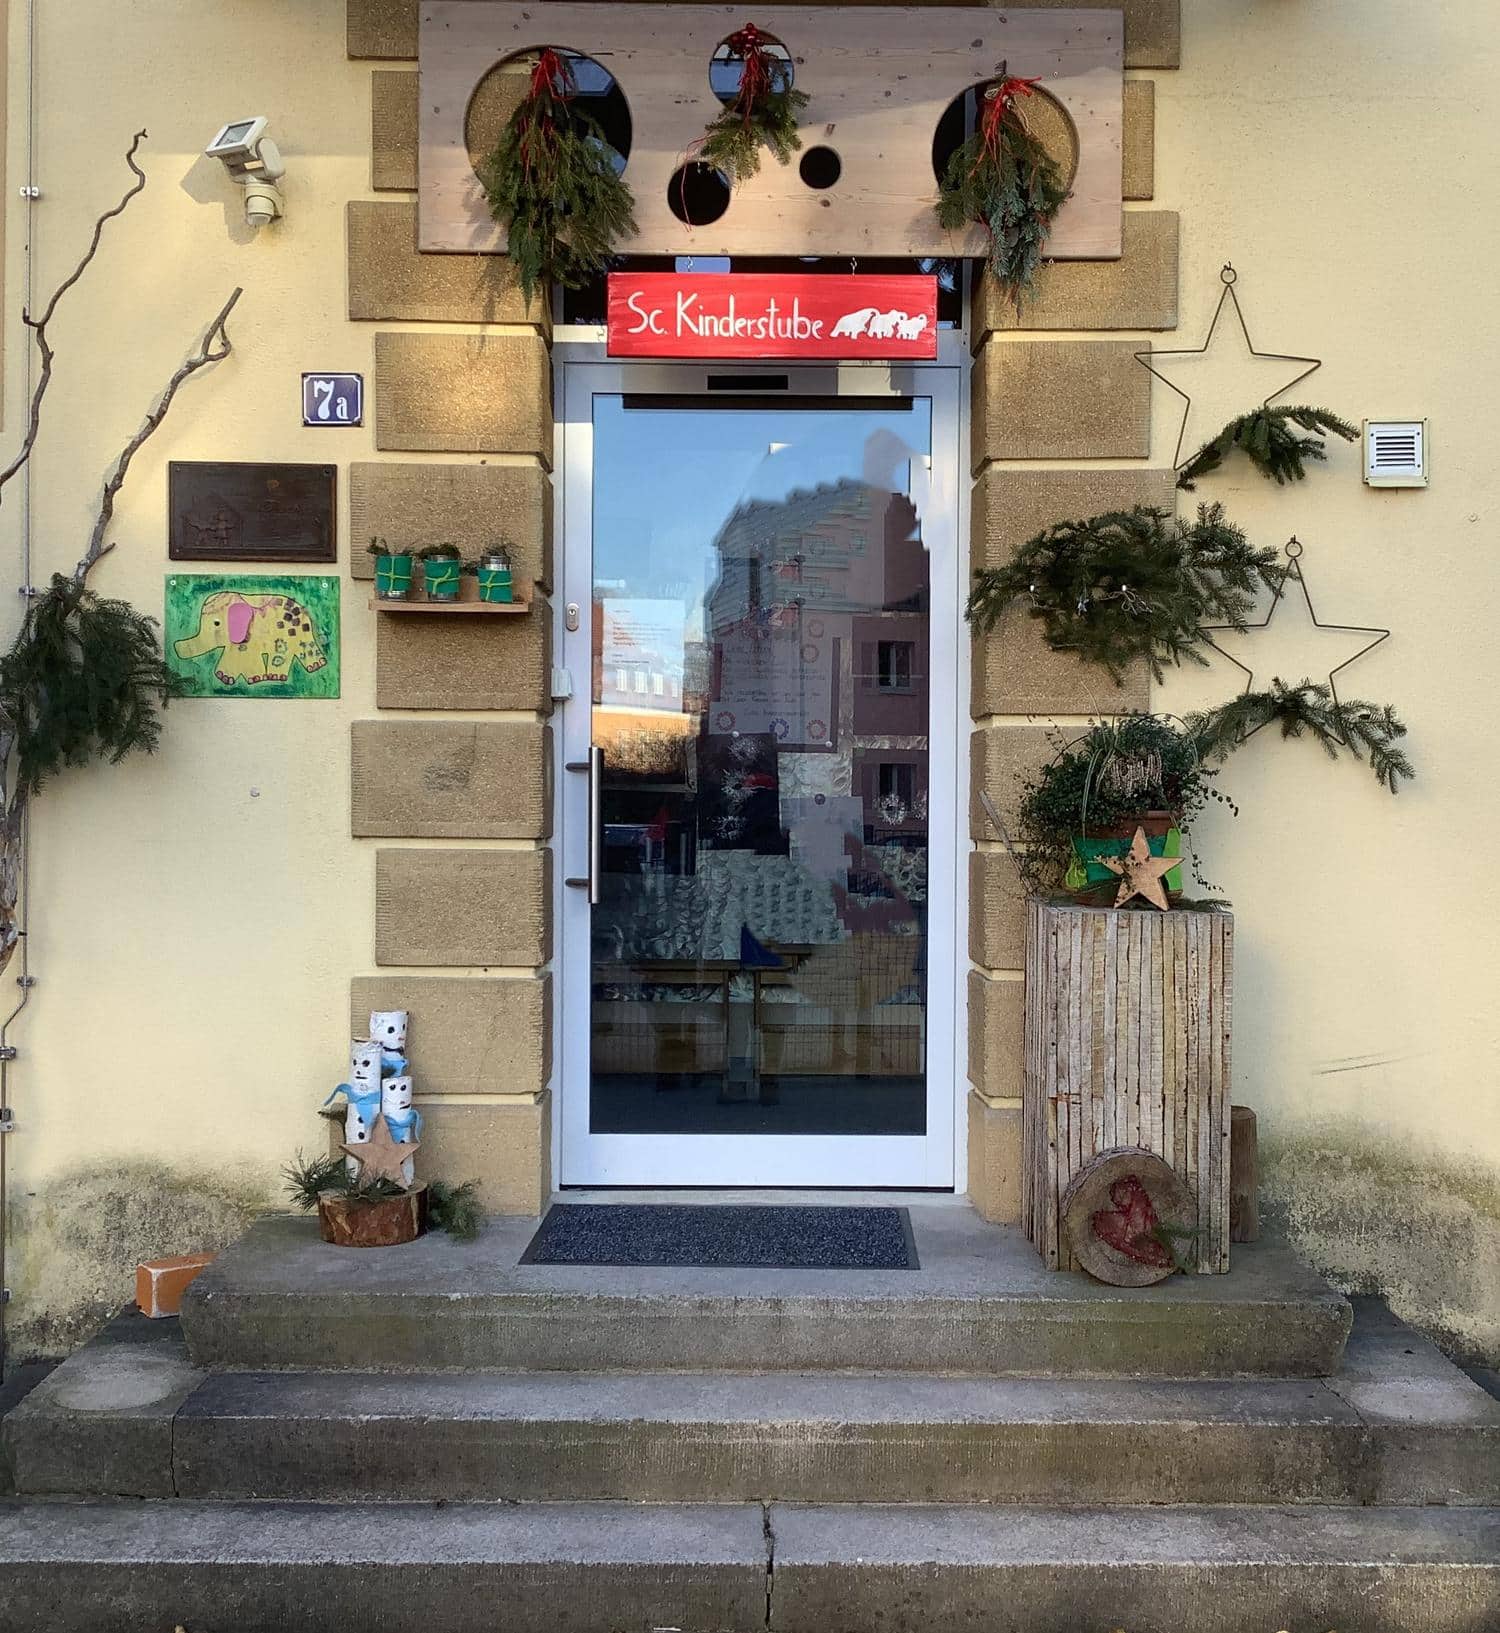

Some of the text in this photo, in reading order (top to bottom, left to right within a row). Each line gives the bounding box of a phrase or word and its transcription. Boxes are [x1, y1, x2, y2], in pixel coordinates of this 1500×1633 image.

[627, 291, 824, 340] Sc. Kinderstube
[313, 380, 349, 420] 7a
